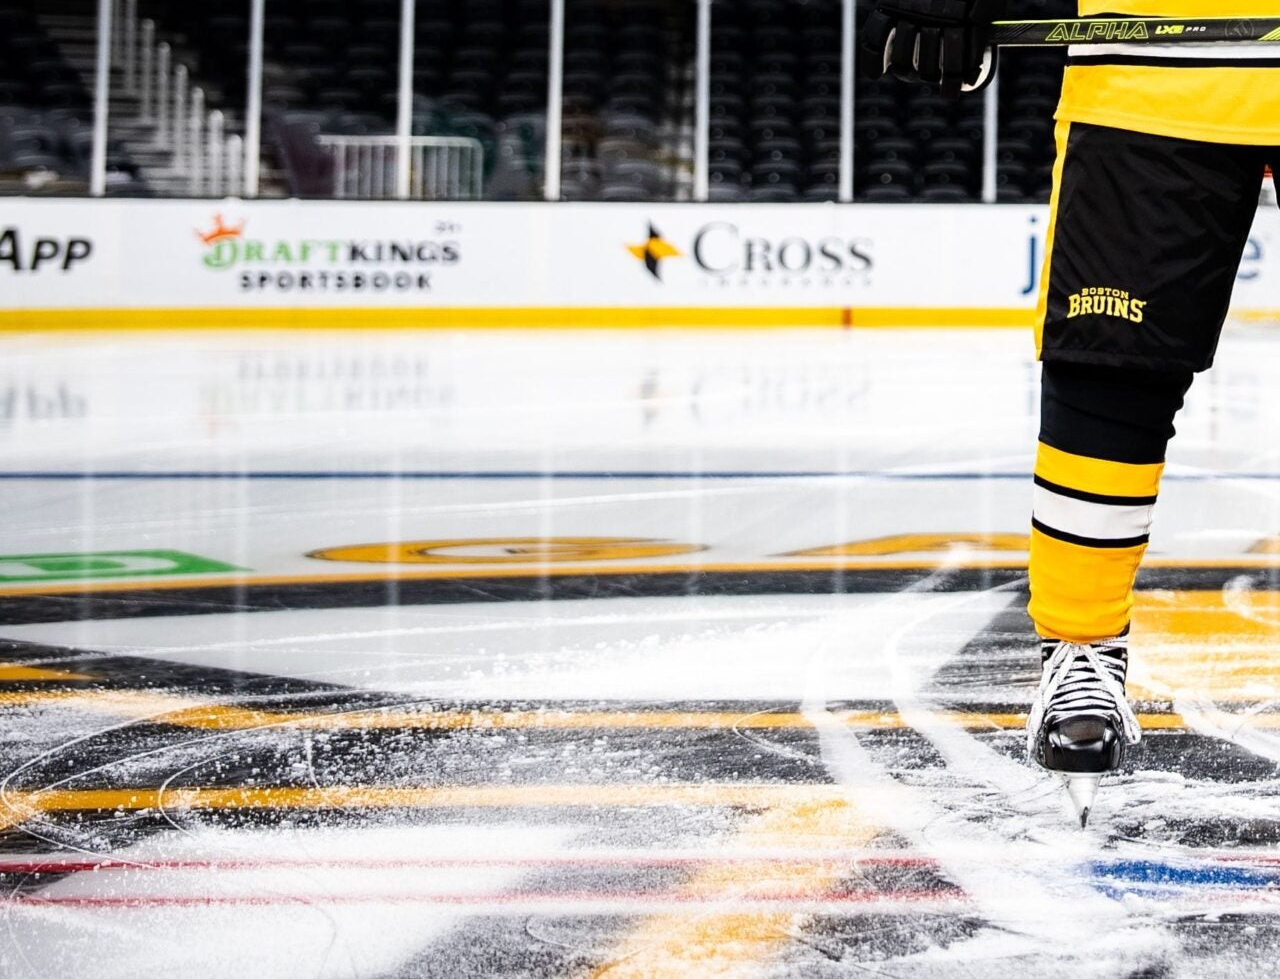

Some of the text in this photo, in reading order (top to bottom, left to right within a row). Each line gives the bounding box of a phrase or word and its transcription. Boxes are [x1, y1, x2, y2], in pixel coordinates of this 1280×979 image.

[1045, 22, 1149, 41] ALPHA
[240, 271, 432, 293] SPORTSBOOK
[1081, 287, 1129, 300] BOSTON
[1067, 293, 1146, 323] BRUINS
